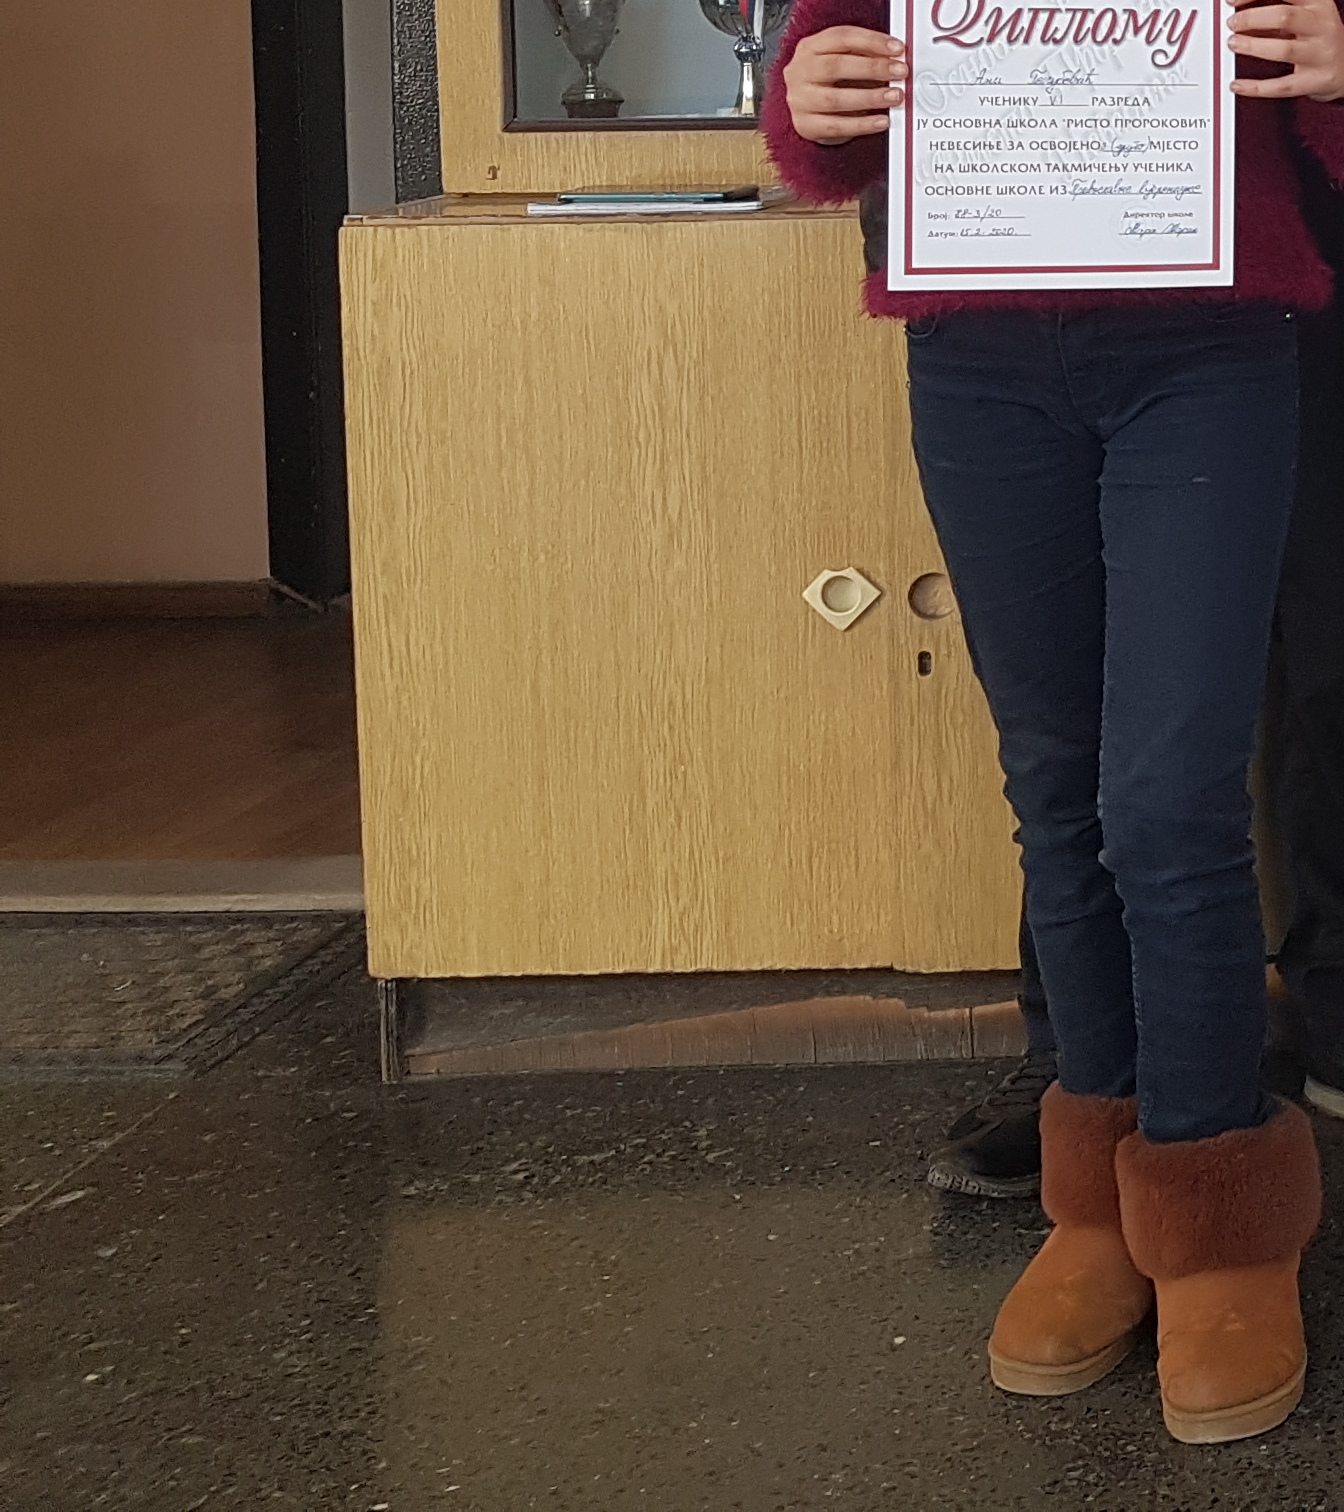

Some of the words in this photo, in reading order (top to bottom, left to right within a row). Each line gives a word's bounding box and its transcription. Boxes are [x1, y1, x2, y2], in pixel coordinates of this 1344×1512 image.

[978, 96, 1039, 107] УЧЕНИКУ
[1091, 96, 1151, 107] РАЗРЕДА
[916, 118, 929, 131] ЈУ
[932, 118, 1003, 129] ОСНОВНА
[1006, 118, 1058, 129] ШКОЛА
[929, 140, 1003, 151] НЕВЕСИЊЕ
[1007, 140, 1025, 151] ЗА
[1028, 140, 1102, 153] ОСВОЈЕНО
[1148, 140, 1199, 153] МЈЕСТО
[934, 163, 955, 174] НА
[958, 162, 1042, 174] ШКОЛСКОМ
[1044, 162, 1129, 173] ТАКМИЧЕЊУ
[1132, 162, 1194, 173] УЧЕНИКА
[924, 185, 992, 196] ОСНОВНЕ
[996, 185, 1046, 196] ШКОЛЕ
[1049, 184, 1068, 195] ИЗ
